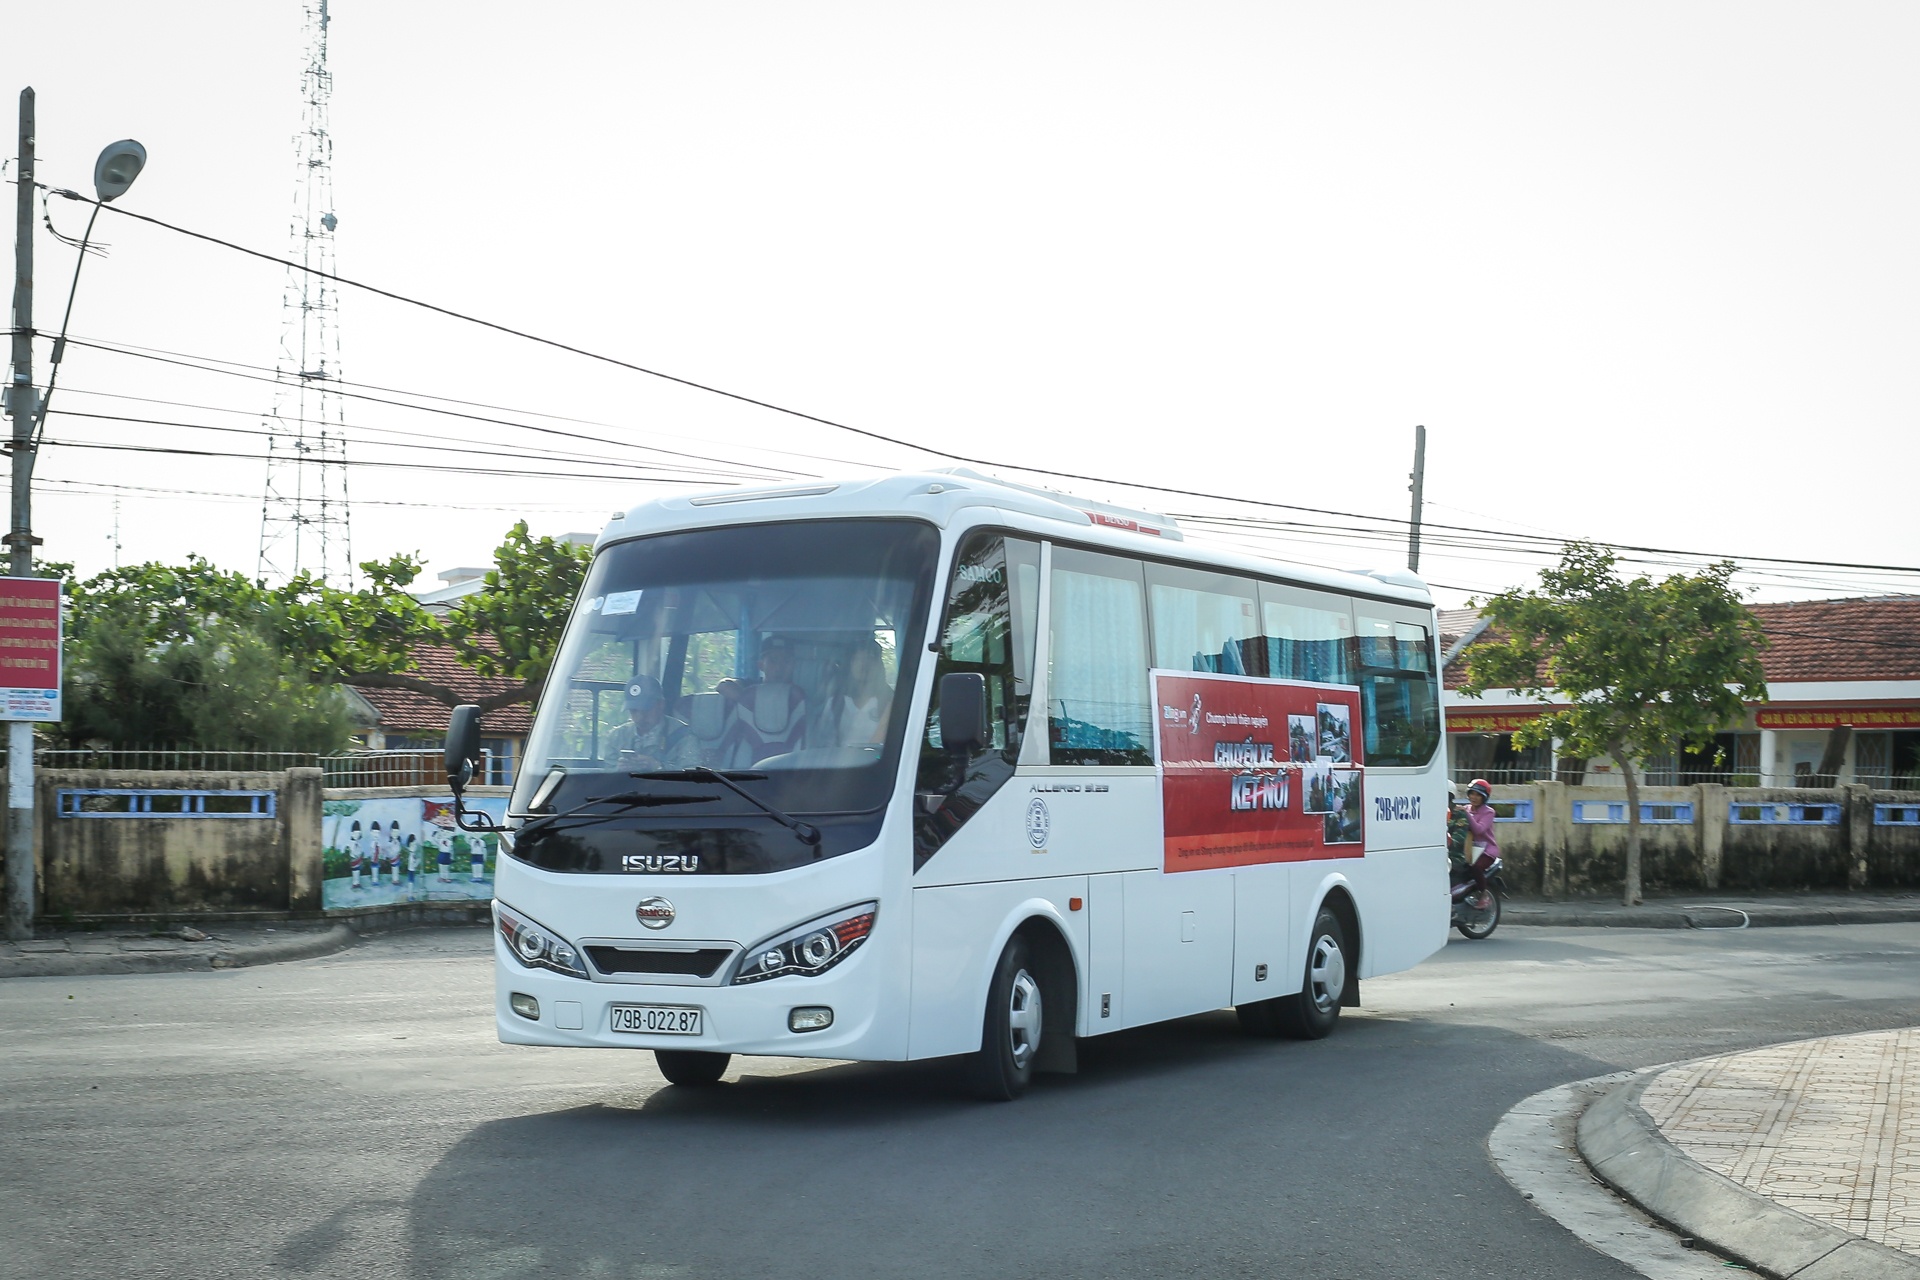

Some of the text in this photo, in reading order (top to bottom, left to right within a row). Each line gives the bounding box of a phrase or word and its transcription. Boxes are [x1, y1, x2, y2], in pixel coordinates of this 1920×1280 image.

[1105, 515, 1130, 526] DENSO
[1214, 736, 1274, 766] CHUYẾN XE
[1231, 765, 1290, 810] KẾT NỐI
[1375, 796, 1421, 821] 79B-022.87
[622, 855, 699, 872] ISUZU
[638, 908, 671, 917] SAMCO
[614, 1009, 698, 1032] 79B-022.87
